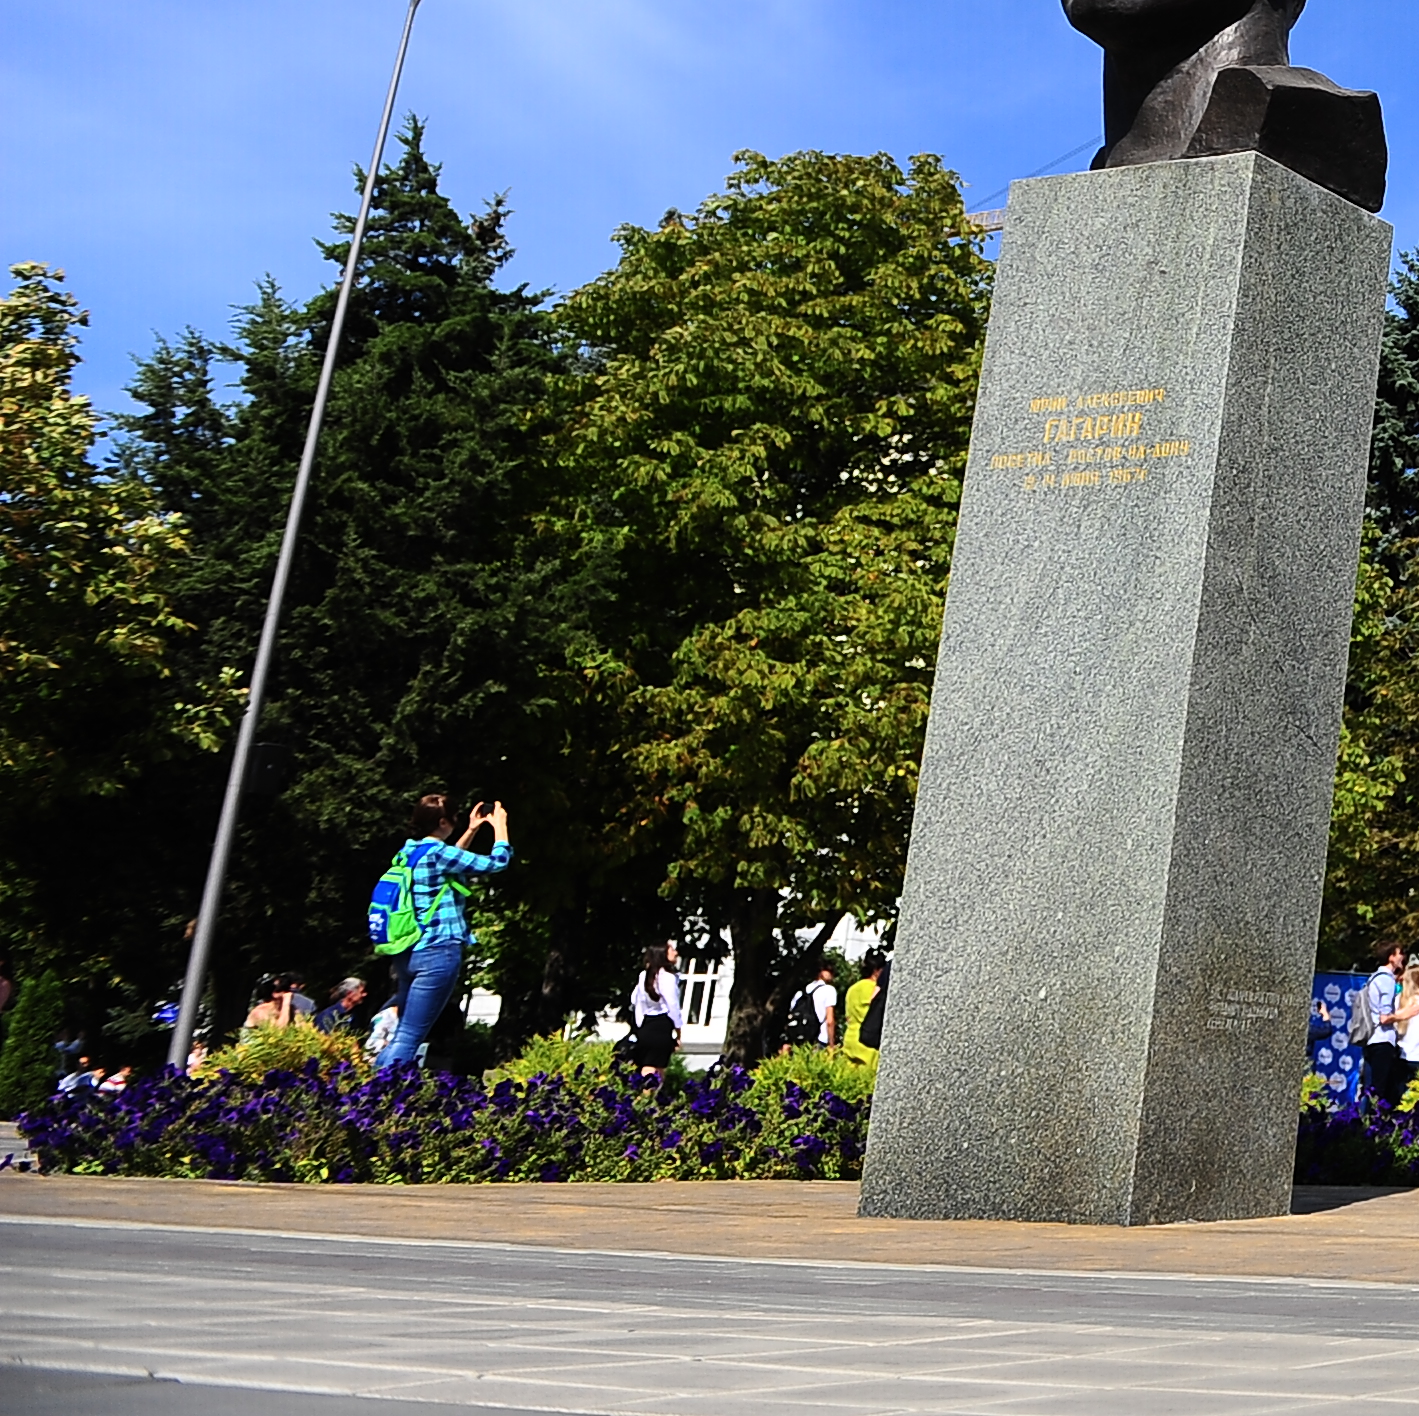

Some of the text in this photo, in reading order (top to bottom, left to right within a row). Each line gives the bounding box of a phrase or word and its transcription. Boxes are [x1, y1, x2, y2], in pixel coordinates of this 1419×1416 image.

[1043, 412, 1143, 444] ГАГАРИН
[990, 440, 1191, 470] ПОСЕТИЛ РОСТОВ-НА-ДОНУ
